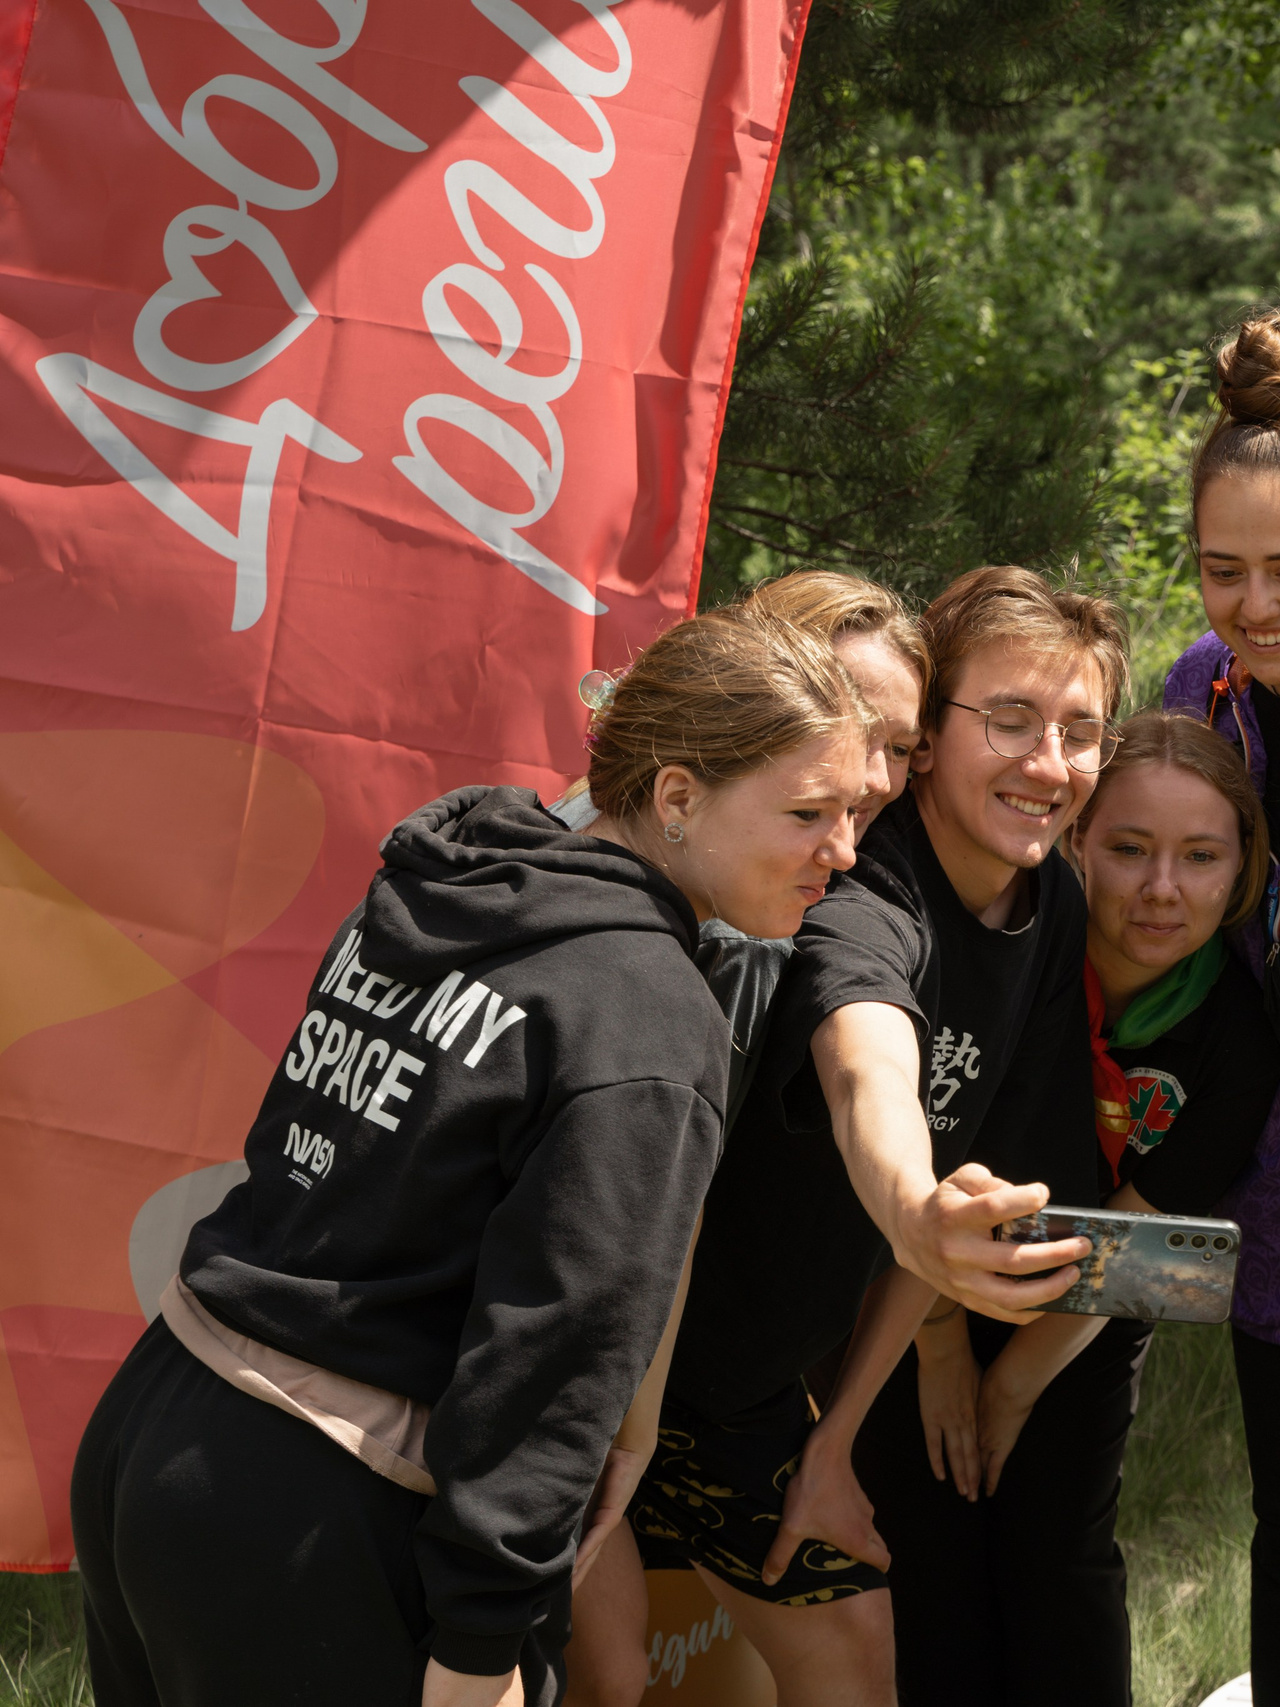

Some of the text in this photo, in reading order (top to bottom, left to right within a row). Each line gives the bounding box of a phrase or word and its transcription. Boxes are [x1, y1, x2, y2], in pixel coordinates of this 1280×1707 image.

[318, 929, 528, 1069] NEED MY
[285, 1009, 427, 1133] SPACE
[283, 1122, 336, 1180] NASA
